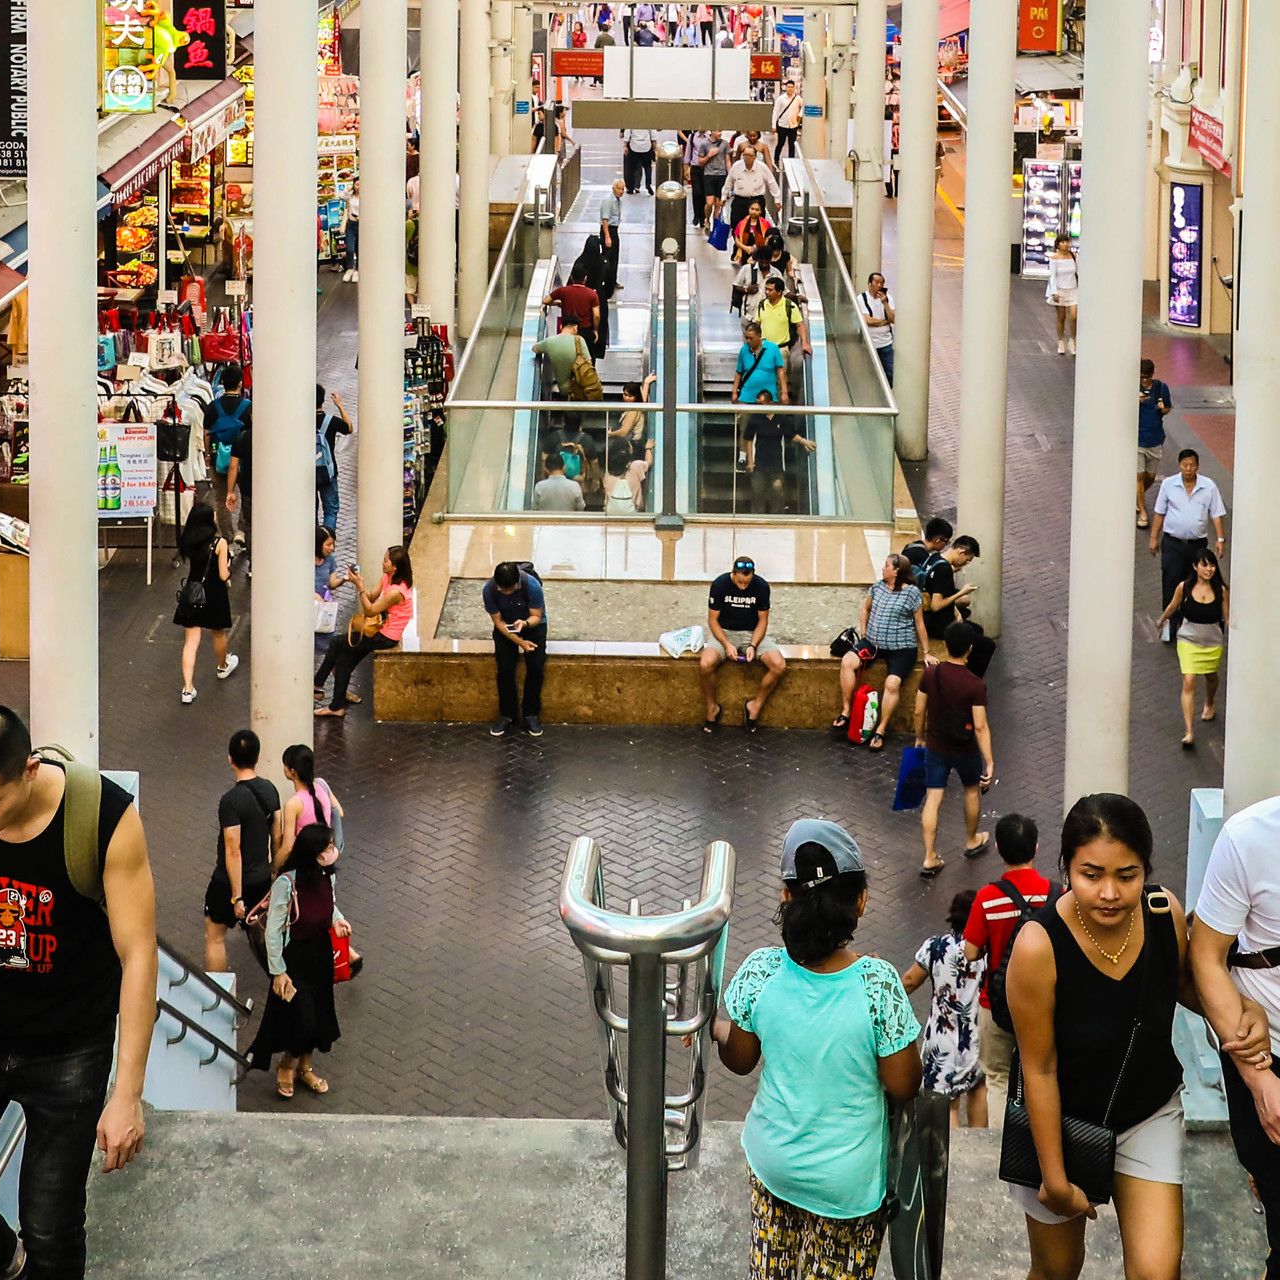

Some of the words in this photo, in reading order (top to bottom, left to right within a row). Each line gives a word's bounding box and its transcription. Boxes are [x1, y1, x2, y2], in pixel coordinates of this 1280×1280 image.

[1030, 7, 1049, 20] PAI
[10, 44, 27, 91] NOTARY
[11, 95, 28, 137] PUBLIC
[29, 932, 58, 962] UP
